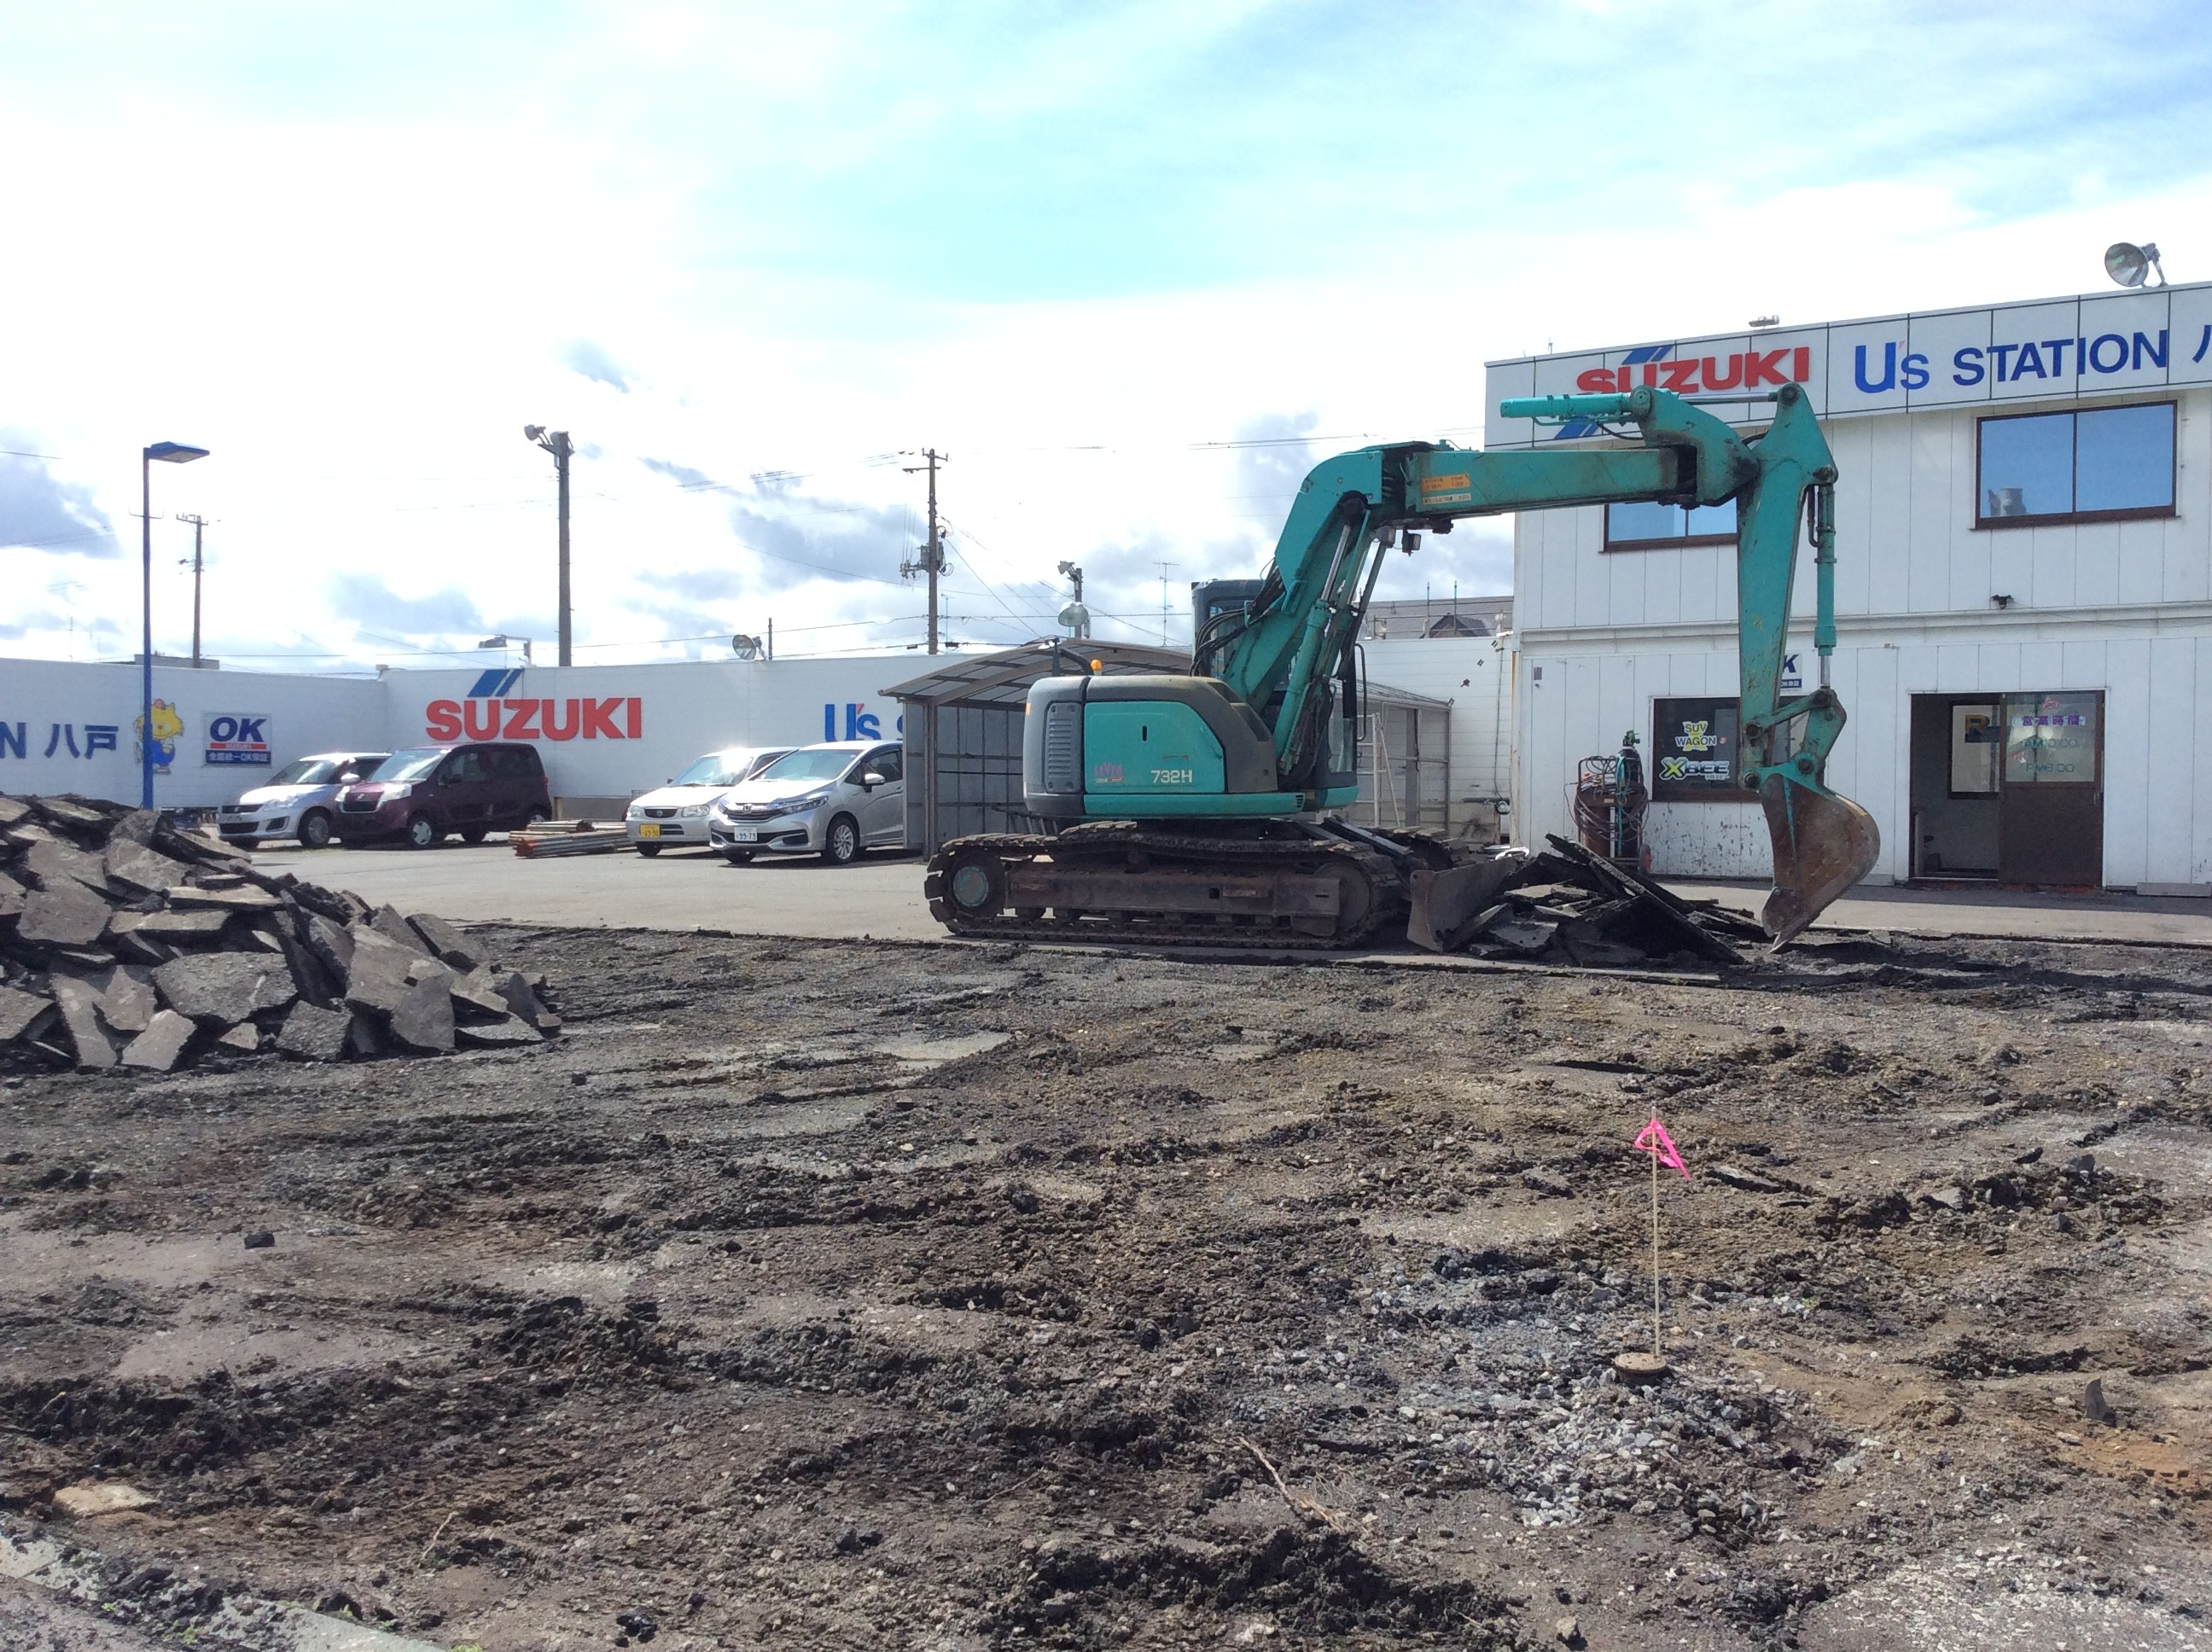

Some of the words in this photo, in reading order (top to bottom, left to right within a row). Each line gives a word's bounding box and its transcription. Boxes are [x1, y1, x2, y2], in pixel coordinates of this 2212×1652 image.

[1577, 346, 1810, 394] SUZUKI
[1953, 329, 2168, 387] STATION
[210, 717, 267, 742] OK
[426, 697, 642, 741] SUZUKI
[1685, 724, 1707, 732] SUV
[44, 724, 119, 759] 八戸
[1675, 736, 1717, 747] WAGON
[1150, 770, 1193, 783] 732H
[1660, 757, 1729, 780] XBEE
